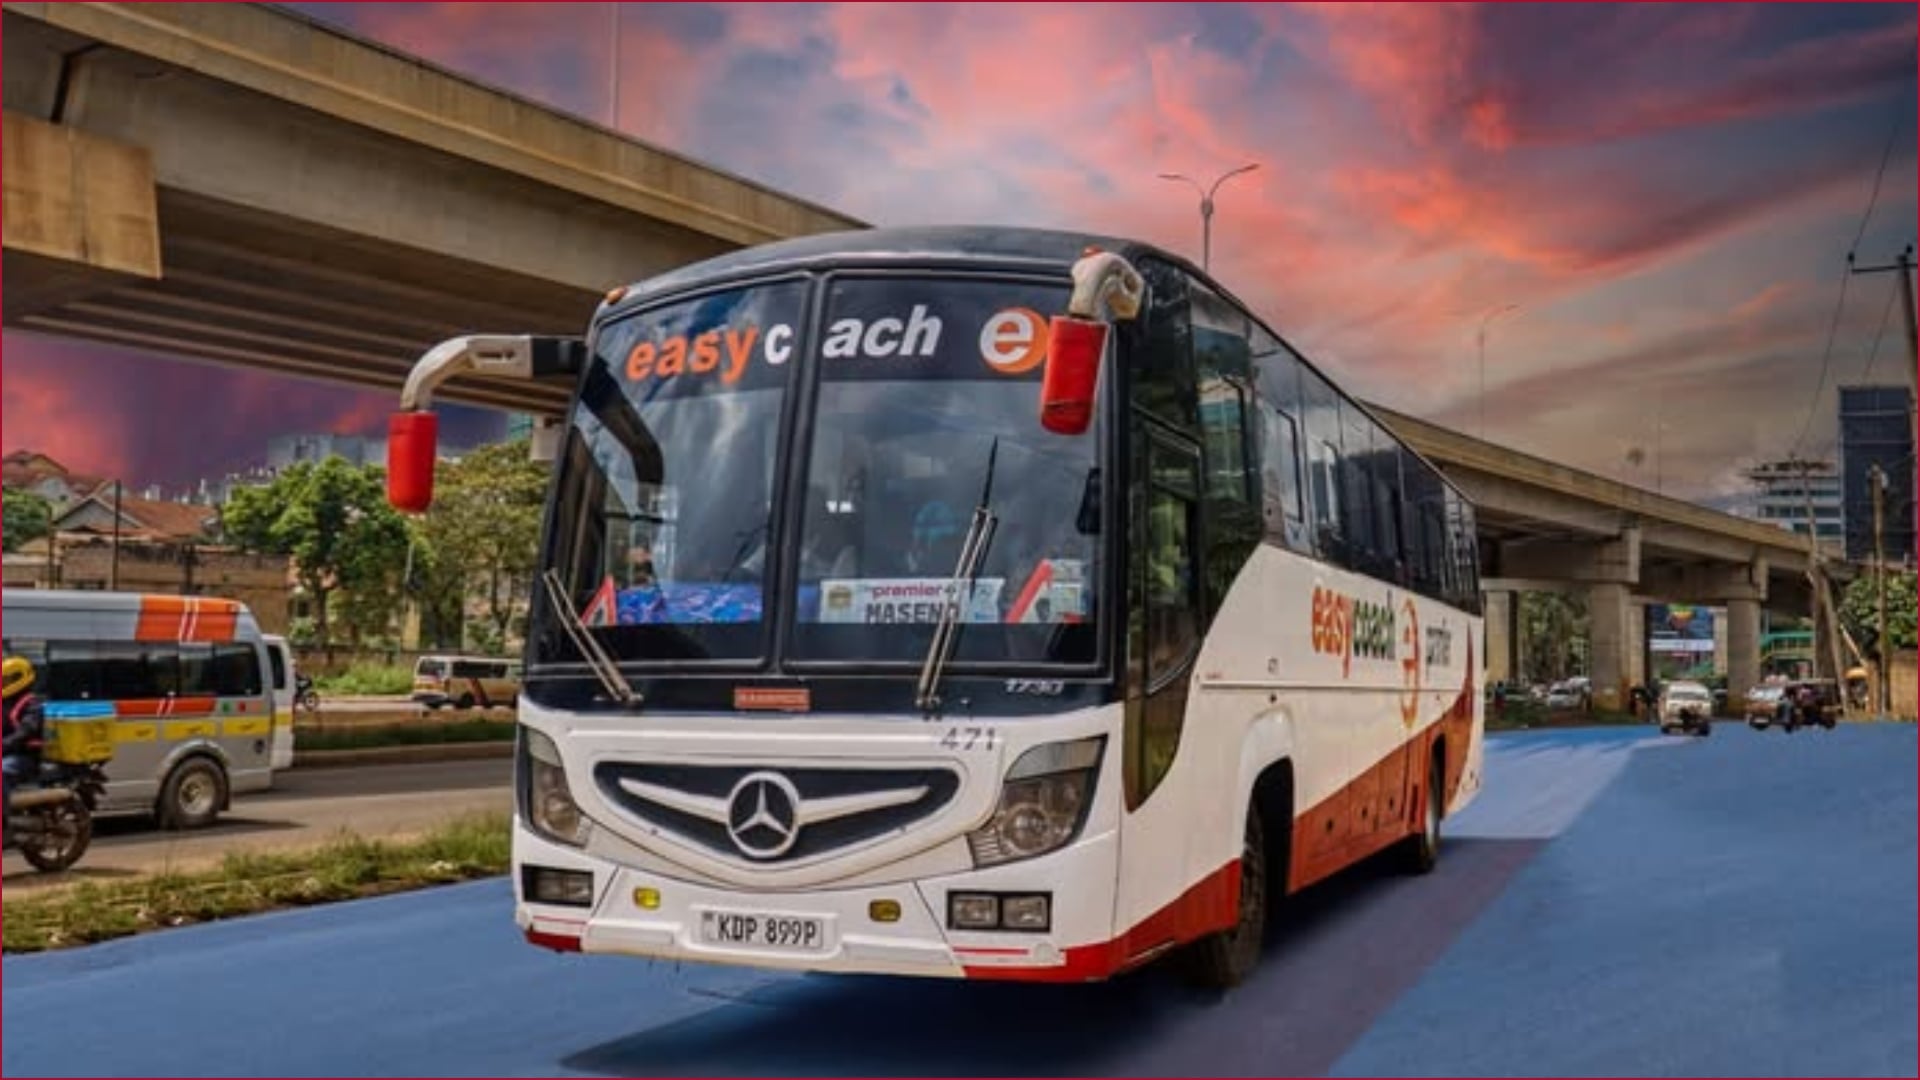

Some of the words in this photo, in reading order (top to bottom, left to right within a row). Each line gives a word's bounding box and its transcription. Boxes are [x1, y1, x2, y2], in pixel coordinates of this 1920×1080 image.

[872, 581, 943, 598] premier
[940, 726, 996, 751] 471
[717, 914, 757, 942] KDP
[765, 918, 816, 945] 899P
